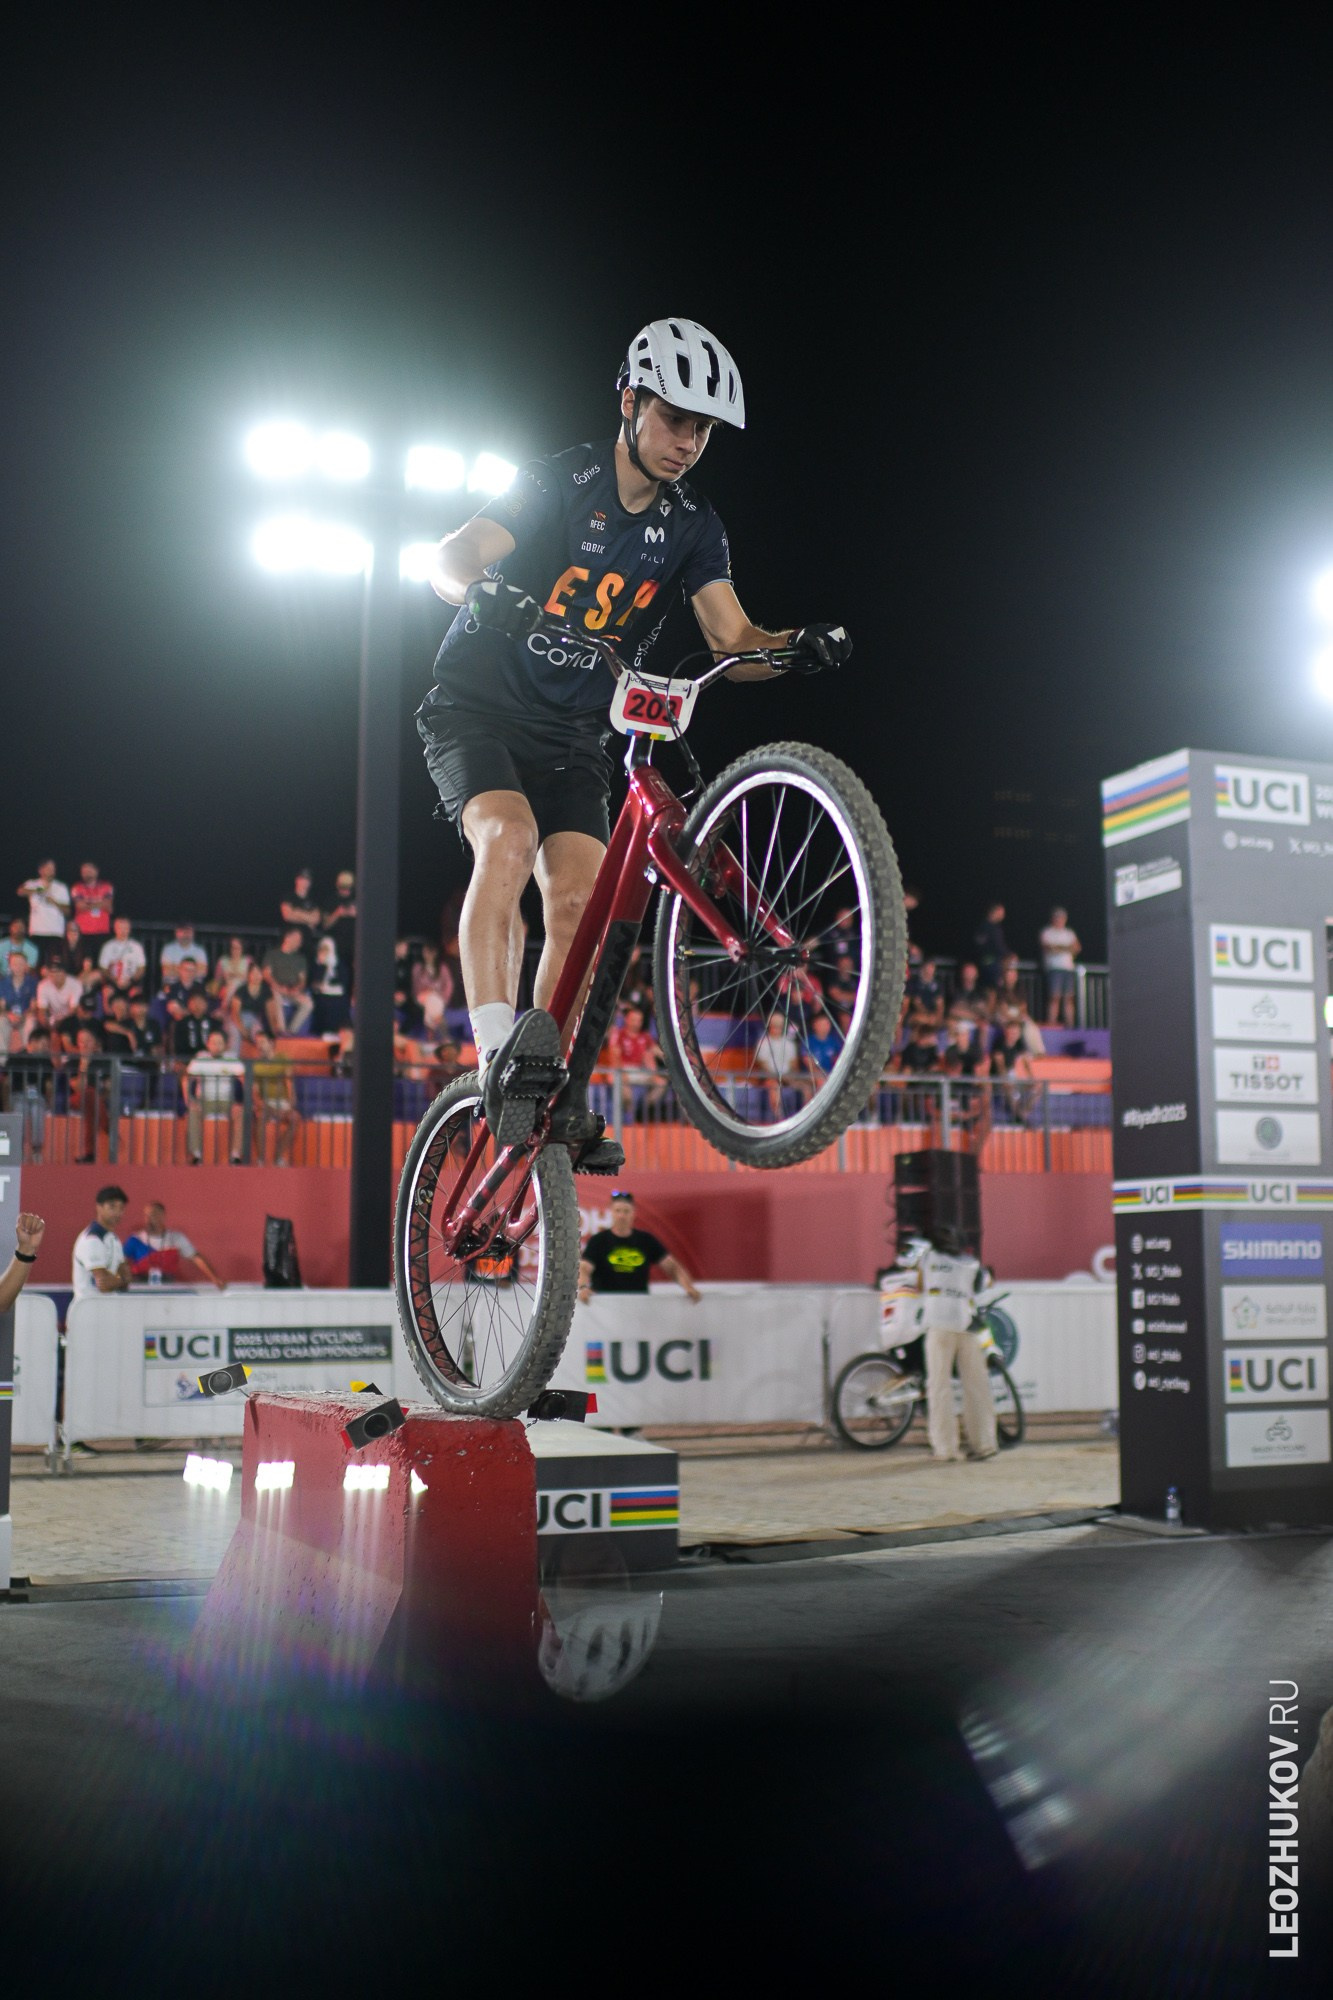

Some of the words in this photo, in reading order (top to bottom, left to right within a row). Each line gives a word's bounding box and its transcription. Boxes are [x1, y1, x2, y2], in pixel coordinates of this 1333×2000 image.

[581, 541, 606, 555] GOBIK
[543, 565, 661, 630] ESP
[1233, 777, 1302, 815] UCI
[1231, 935, 1302, 972] UCI
[1229, 1073, 1303, 1090] TISSOT
[1141, 1185, 1171, 1205] UCI
[1251, 1183, 1292, 1204] UCI
[1222, 1240, 1322, 1261] SHIMANO
[159, 1335, 221, 1360] UCI
[234, 1334, 263, 1345] 2025
[264, 1333, 308, 1345] URBAN
[309, 1331, 364, 1344] CYCLING
[234, 1347, 282, 1360] WORLD
[283, 1344, 388, 1359] CHAMPIONSHIPS
[610, 1339, 711, 1383] UCI
[1247, 1358, 1316, 1392] UCI
